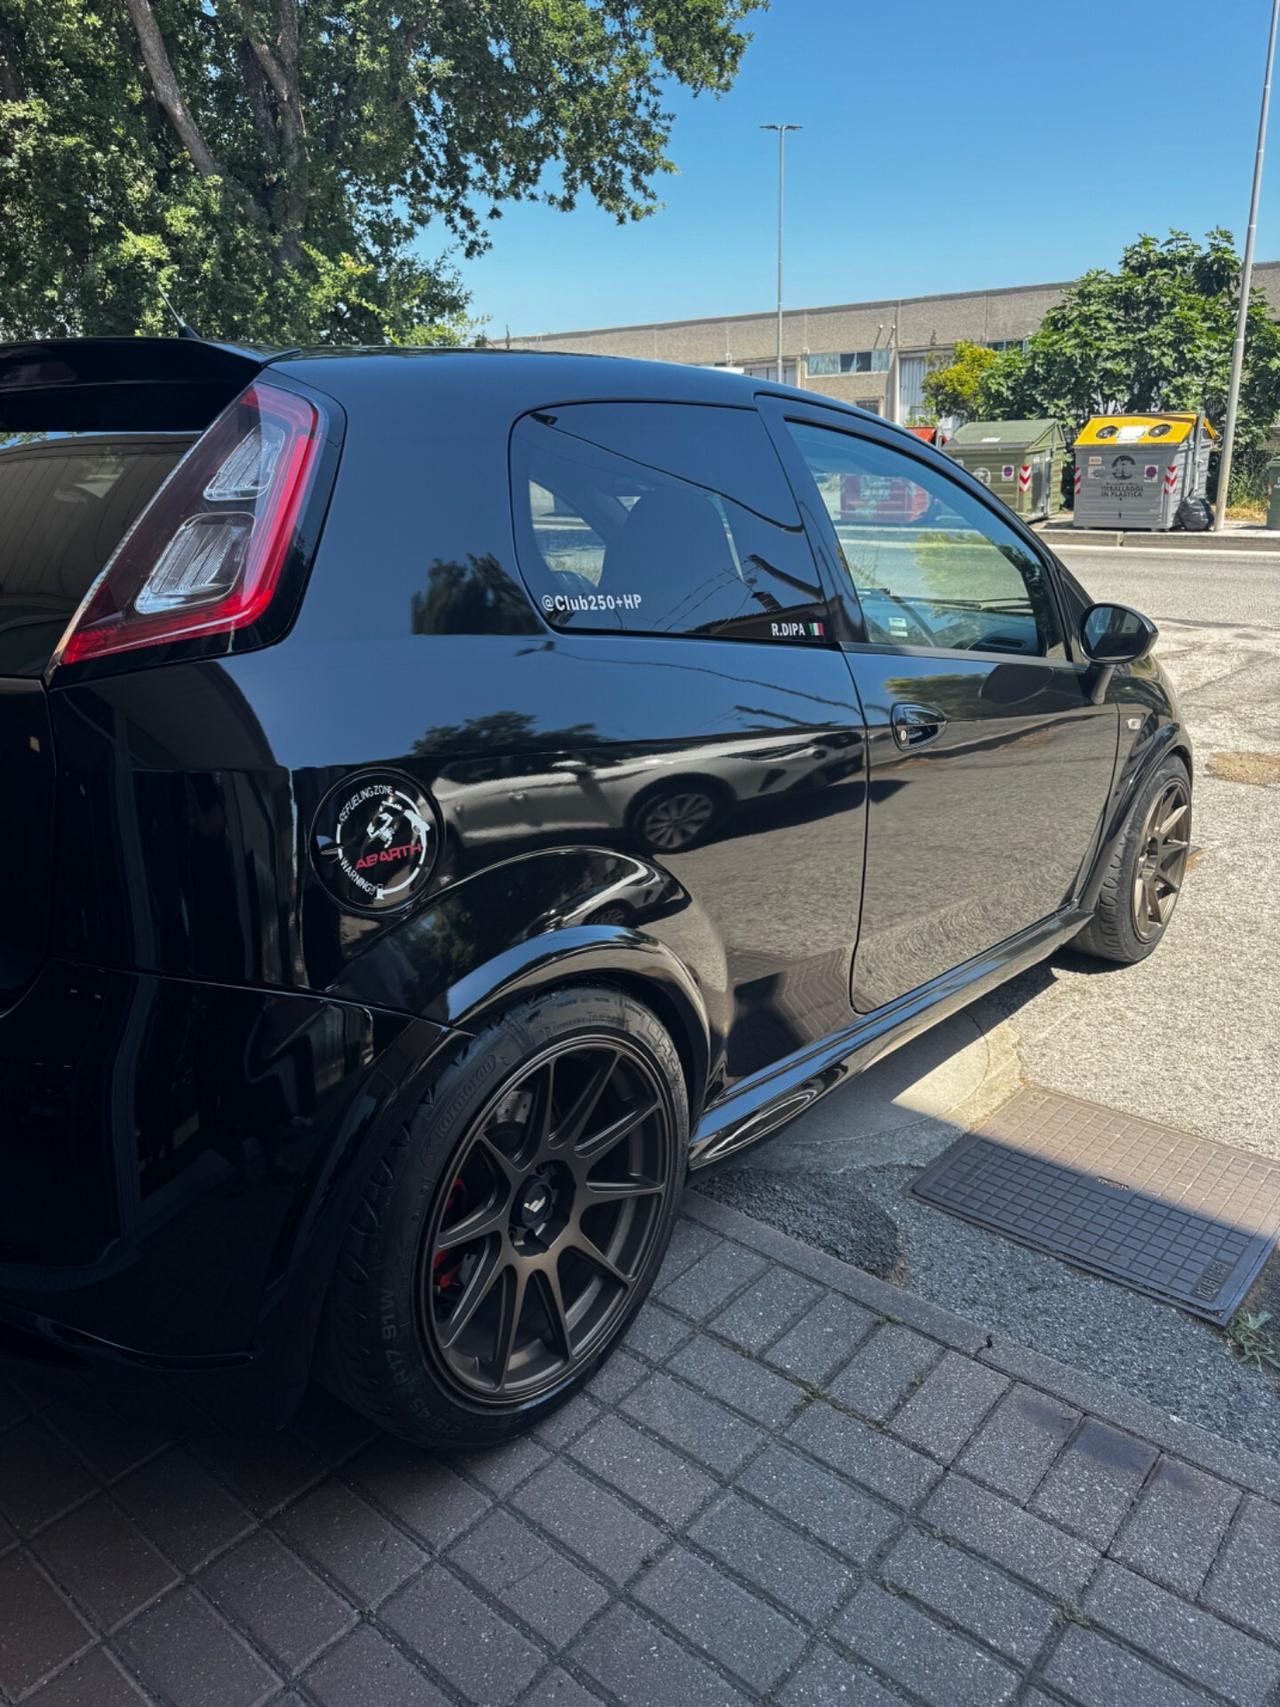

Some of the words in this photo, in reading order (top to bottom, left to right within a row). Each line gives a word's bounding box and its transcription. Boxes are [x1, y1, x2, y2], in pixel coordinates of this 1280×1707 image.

[541, 593, 642, 612] @Club250+HP
[771, 622, 806, 636] R.DIPA
[355, 843, 423, 870] ABARTH
